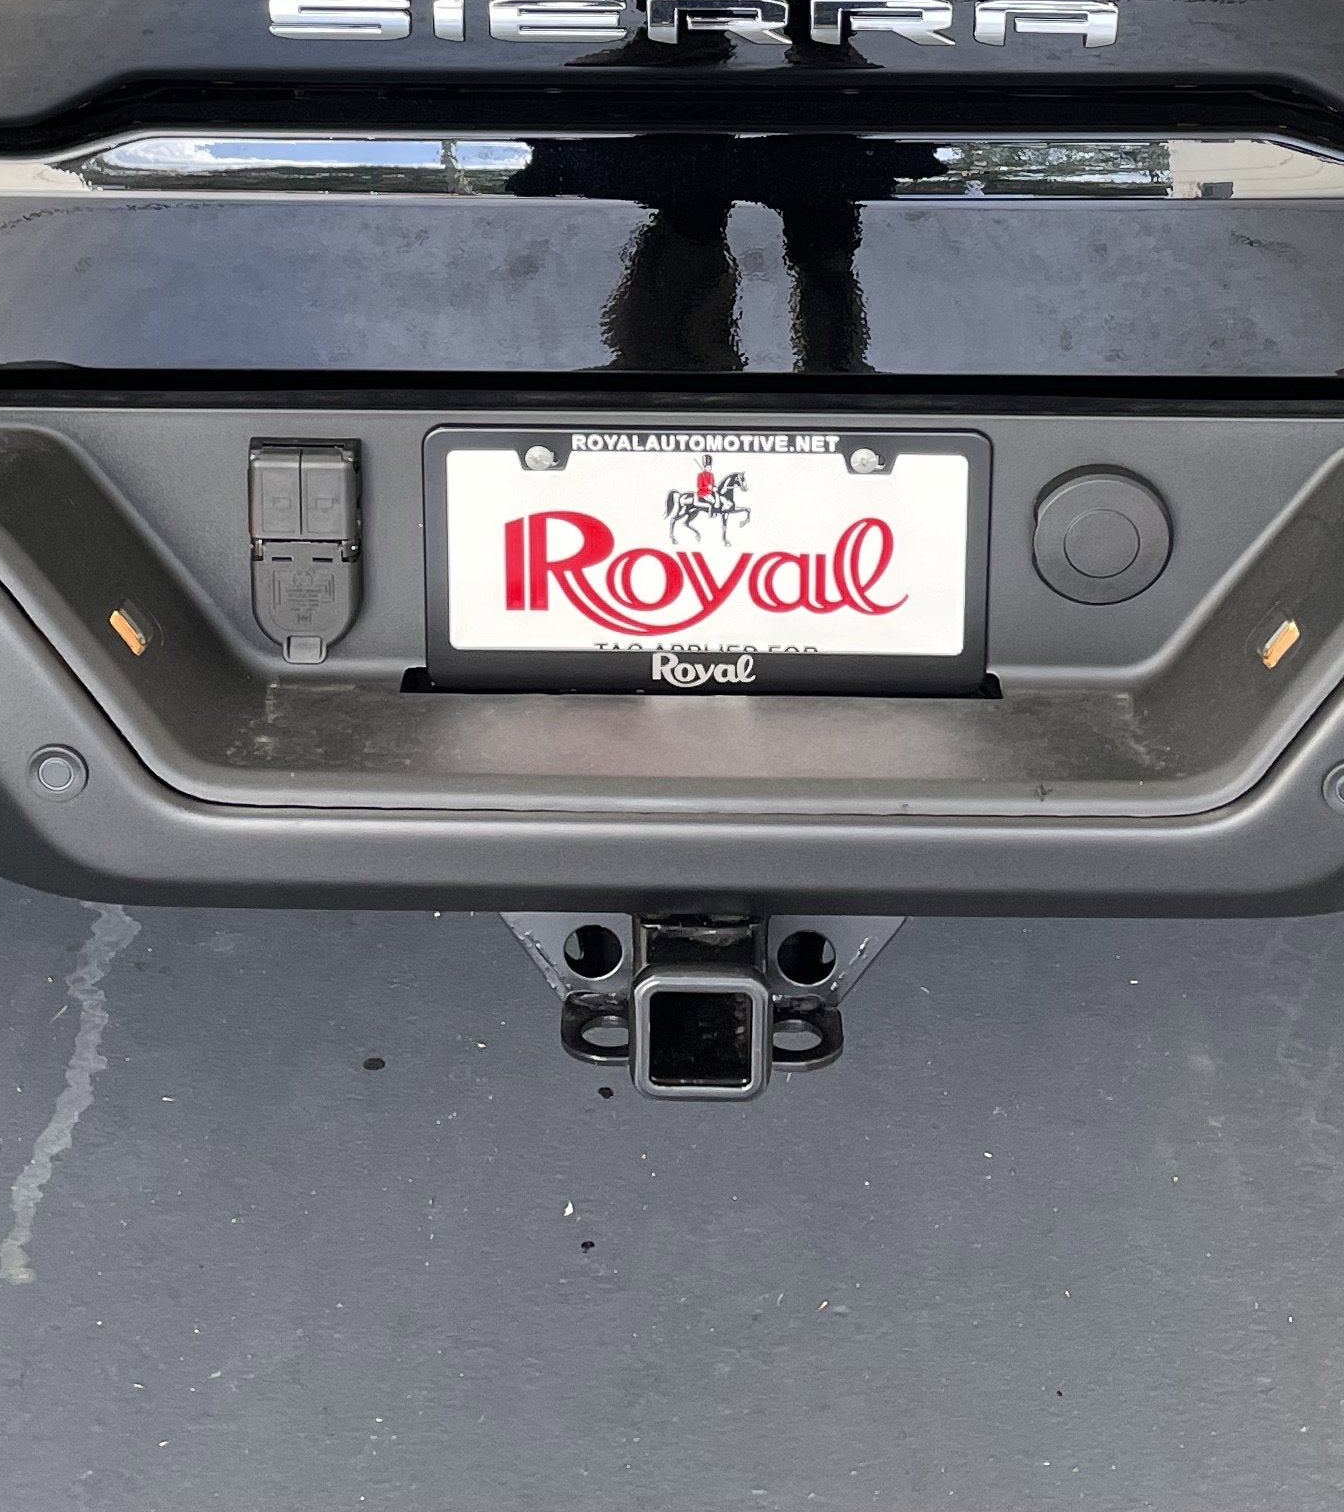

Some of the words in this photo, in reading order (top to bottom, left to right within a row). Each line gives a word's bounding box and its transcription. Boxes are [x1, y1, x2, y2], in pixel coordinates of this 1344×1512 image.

[570, 433, 841, 453] ROYALAUTOMOTIVE.NET
[504, 510, 909, 636] Royal
[651, 651, 756, 688] Royal
